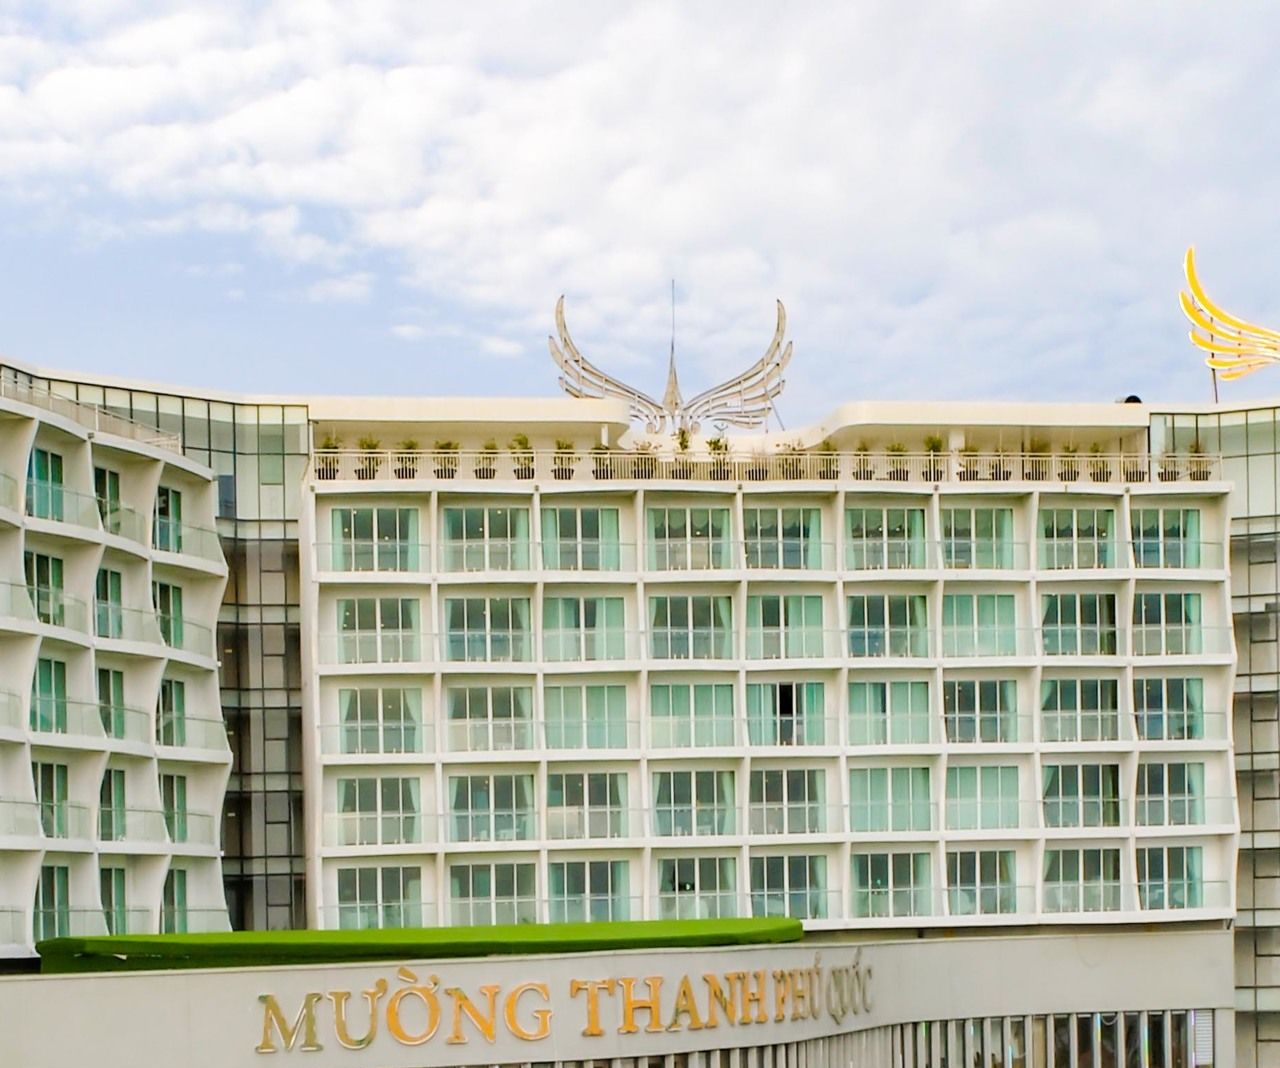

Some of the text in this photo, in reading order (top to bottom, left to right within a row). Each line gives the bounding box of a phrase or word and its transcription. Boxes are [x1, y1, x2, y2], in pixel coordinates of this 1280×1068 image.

[255, 966, 553, 1053] MƯỜNG
[569, 968, 768, 1038] THANH
[772, 952, 822, 1024] PHÚ
